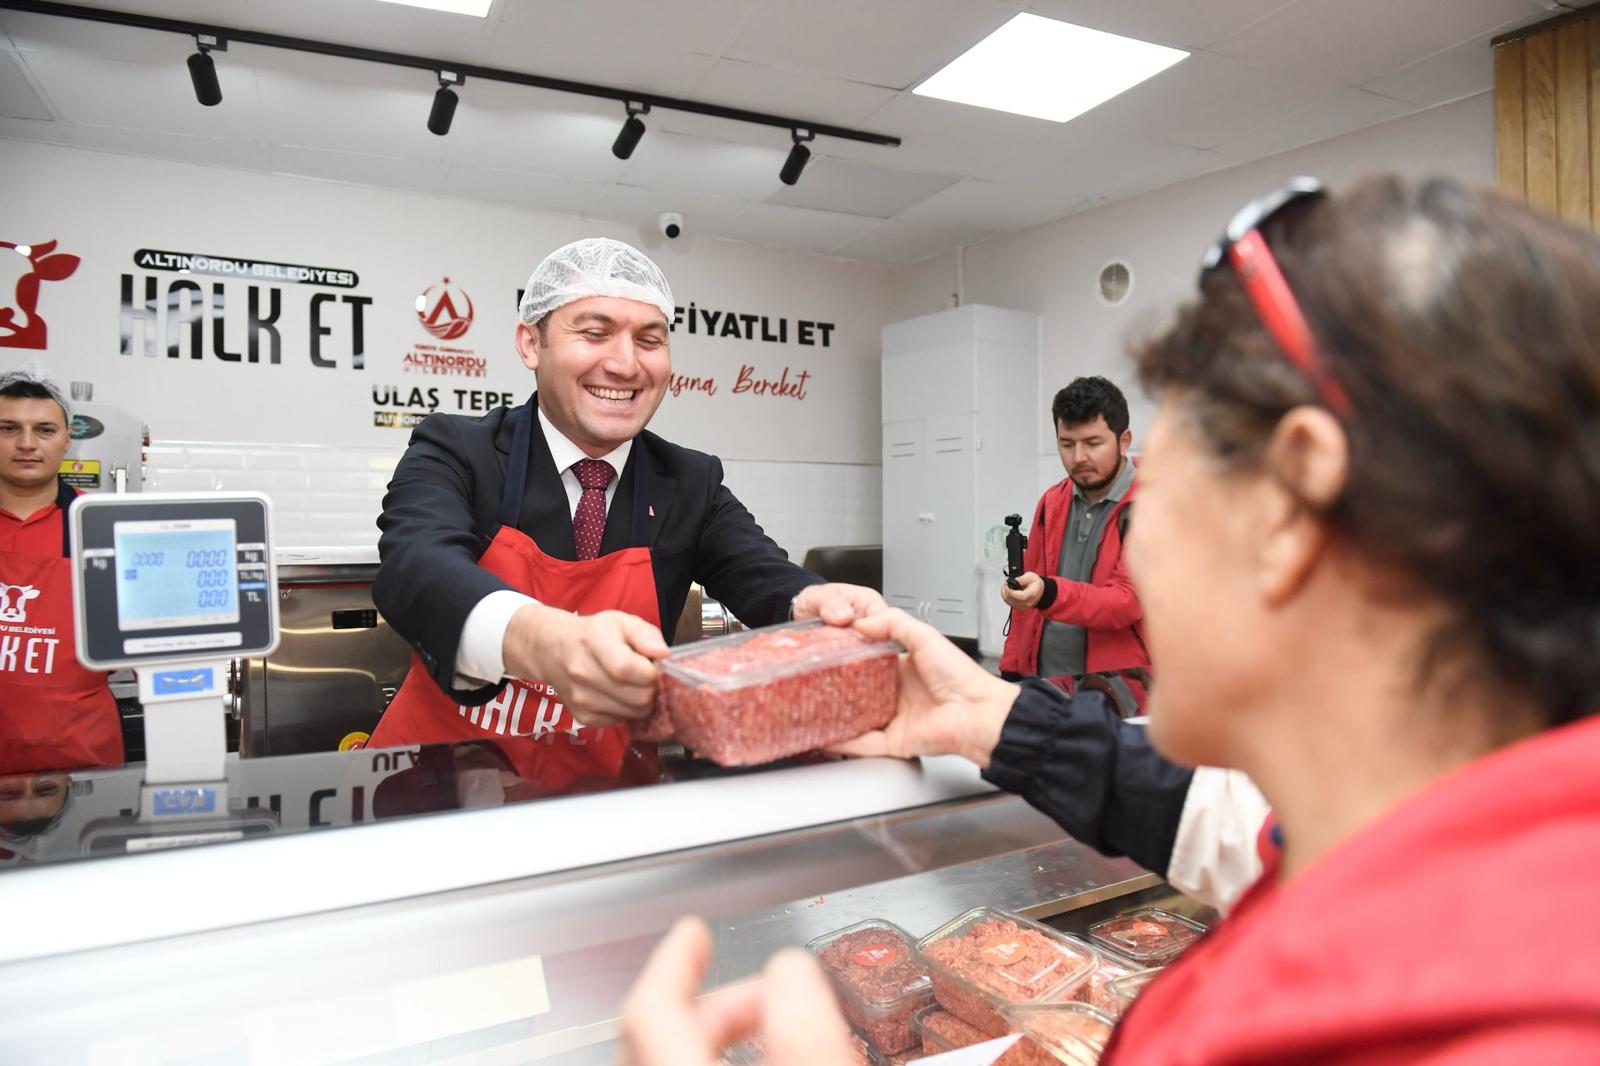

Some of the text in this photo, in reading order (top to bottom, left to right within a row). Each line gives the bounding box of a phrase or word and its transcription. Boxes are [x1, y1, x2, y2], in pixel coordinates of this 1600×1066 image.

[140, 252, 354, 286] ALTINORDU BELEDİYESİ
[120, 274, 373, 370] HALK ET
[669, 301, 835, 347] FİYATLI ET
[404, 353, 487, 369] ALTINORDU
[372, 384, 440, 413] ULAŞ
[731, 364, 812, 401] Bereket
[25, 638, 59, 673] ET
